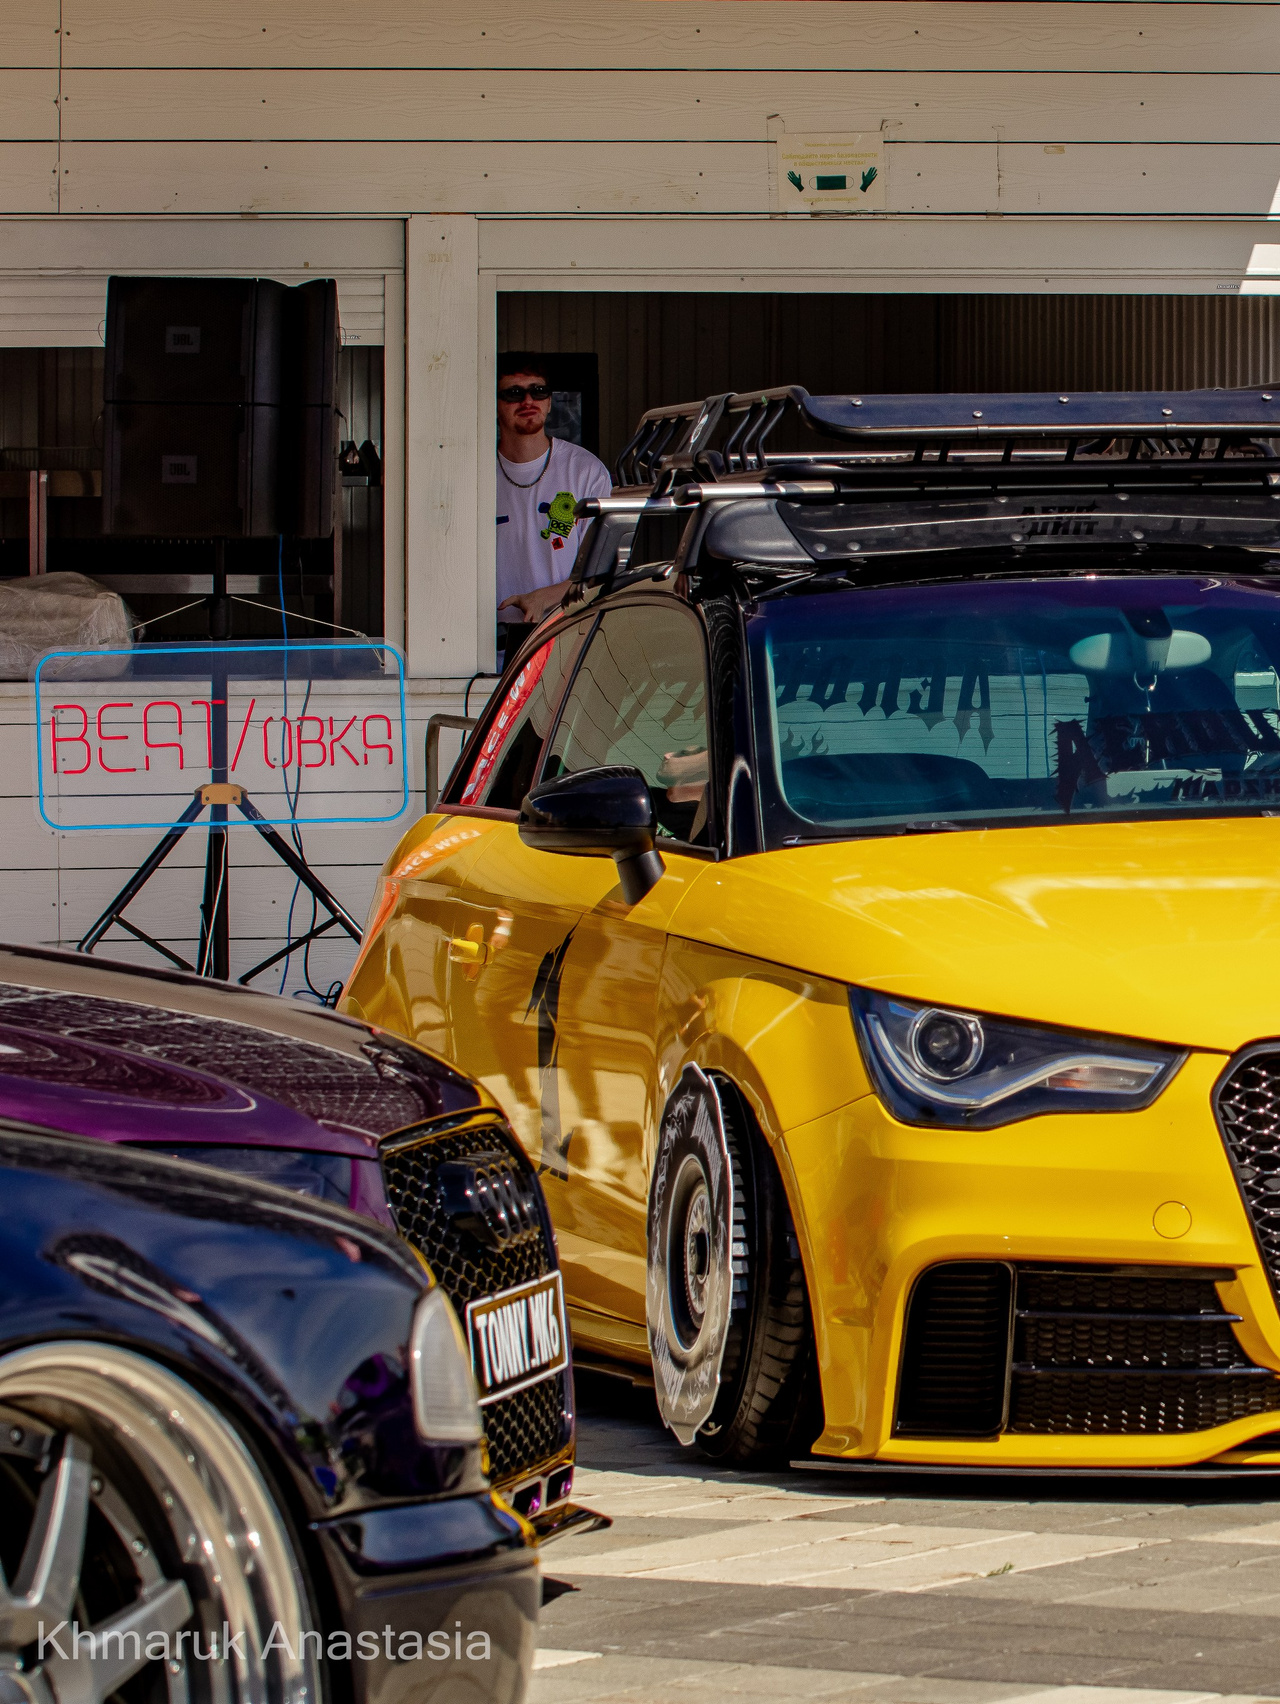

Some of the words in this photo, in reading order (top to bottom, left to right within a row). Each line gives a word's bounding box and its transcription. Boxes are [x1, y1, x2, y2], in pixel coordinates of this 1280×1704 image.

[173, 333, 194, 346] JBL
[169, 462, 191, 476] JBL
[1027, 520, 1100, 538] UNIT
